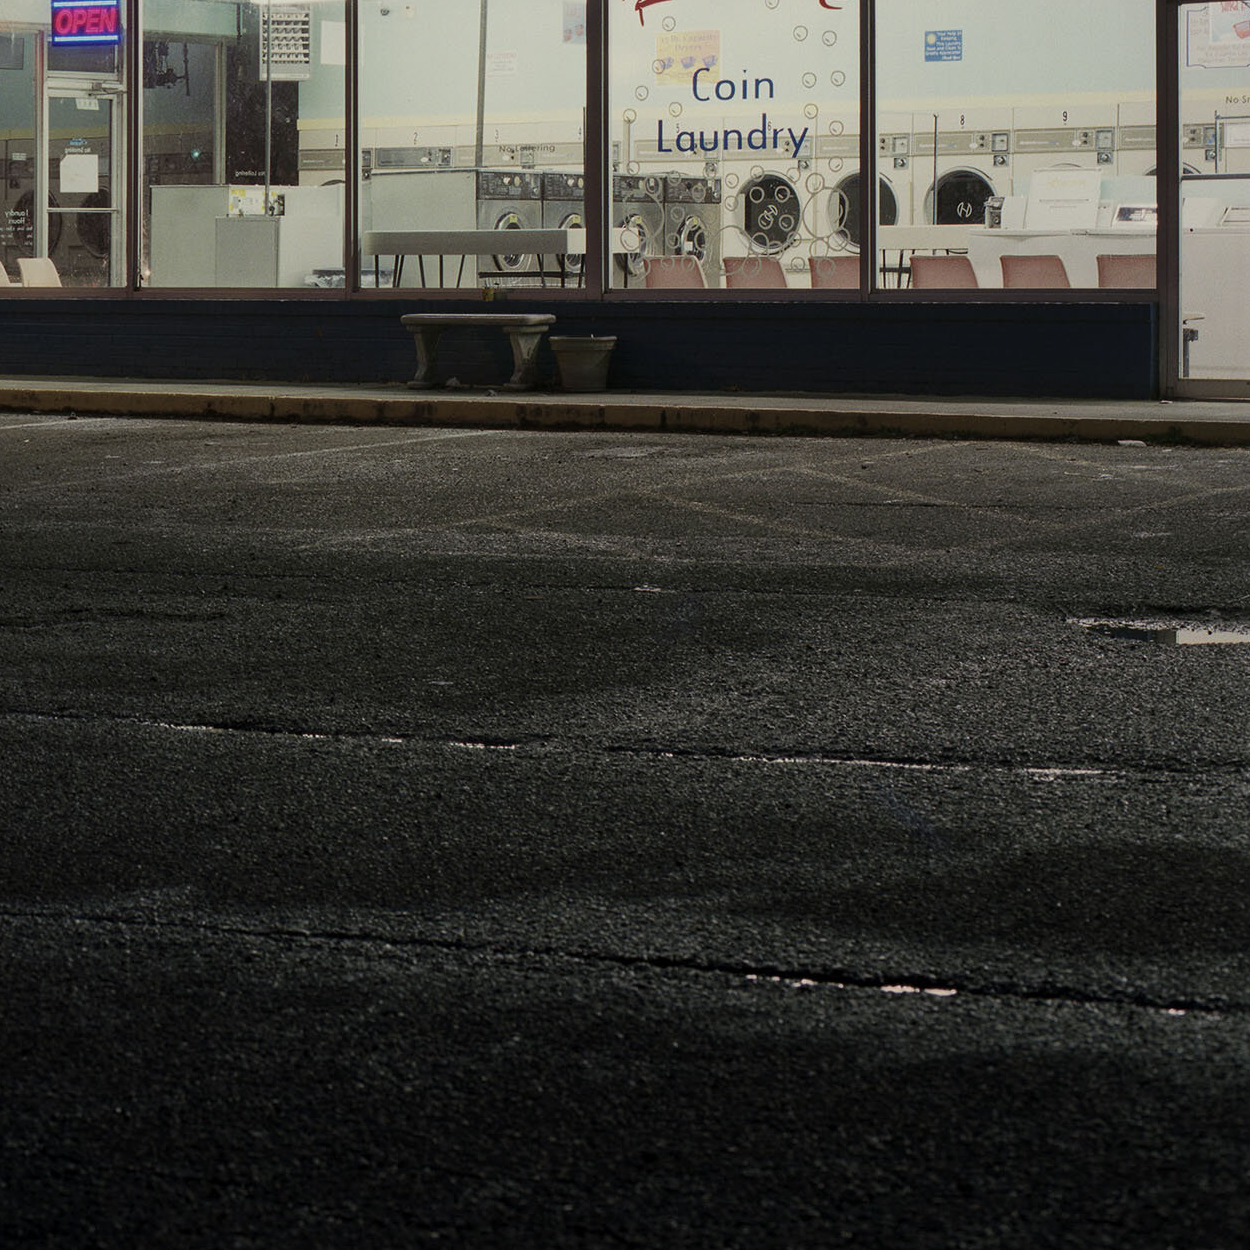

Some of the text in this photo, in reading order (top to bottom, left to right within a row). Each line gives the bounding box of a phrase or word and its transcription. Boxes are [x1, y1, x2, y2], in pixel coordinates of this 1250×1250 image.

[55, 6, 117, 35] OPEN
[692, 68, 774, 101] Coin
[1225, 96, 1239, 104] No
[959, 114, 965, 126] 8
[1062, 110, 1068, 122] 9
[657, 113, 809, 158] Laundry
